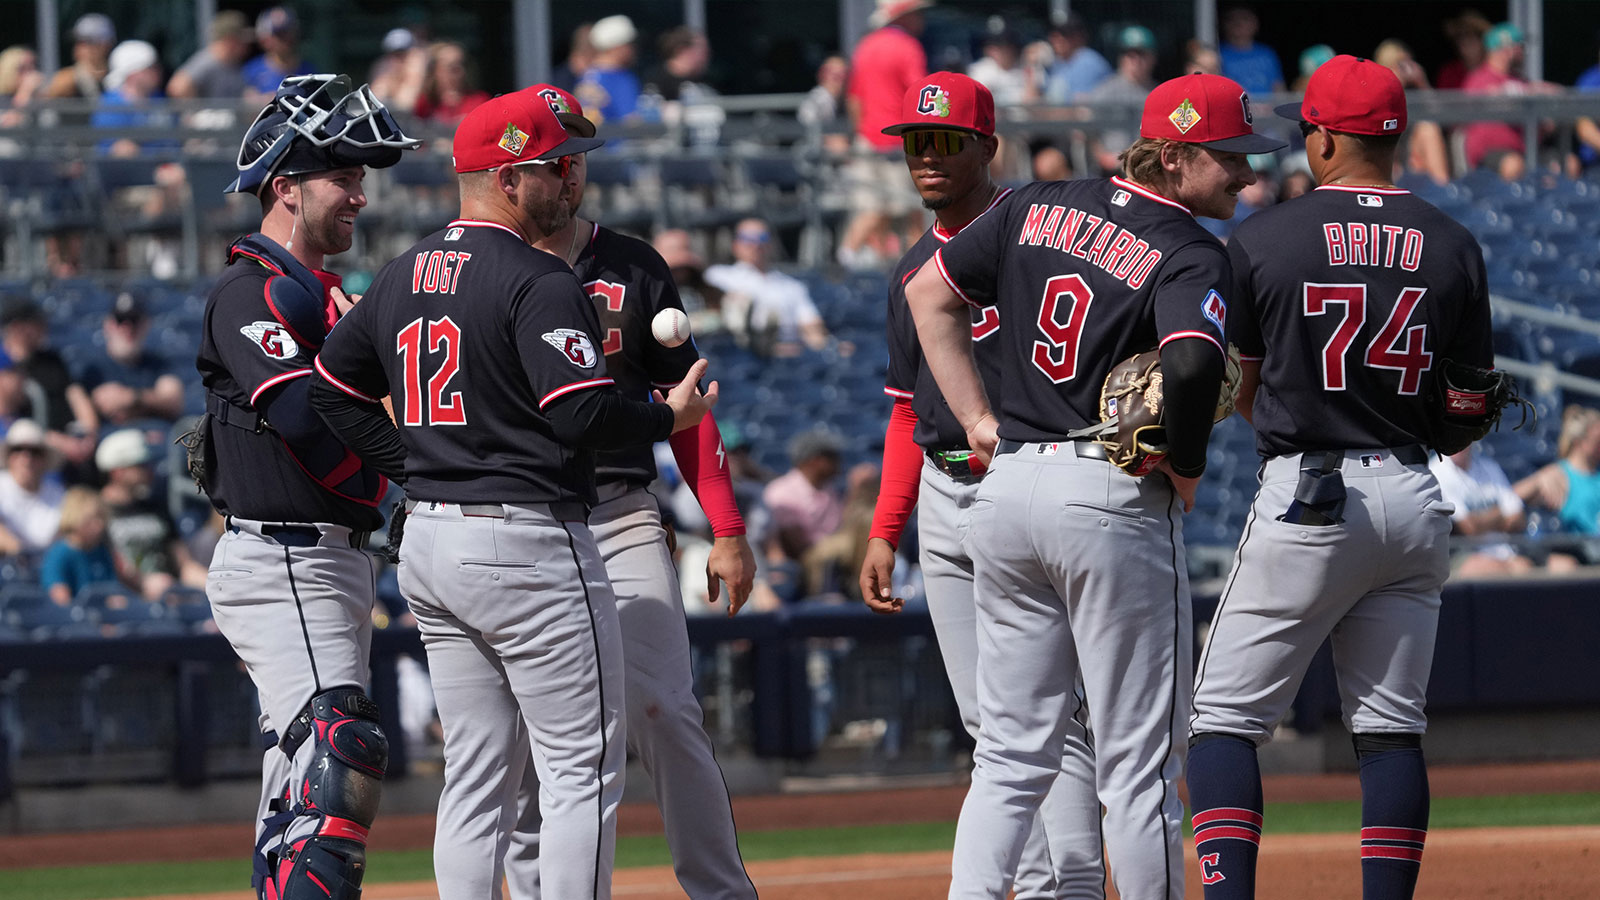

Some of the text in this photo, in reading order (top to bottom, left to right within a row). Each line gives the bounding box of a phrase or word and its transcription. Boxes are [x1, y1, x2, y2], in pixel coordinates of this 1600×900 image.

[916, 84, 940, 115] C
[1175, 108, 1194, 123] 26
[503, 129, 522, 148] 26
[1018, 203, 1163, 291] MANZARDO
[1322, 222, 1425, 272] BRITO
[412, 250, 473, 294] VOGT
[1031, 273, 1095, 384] 9
[1303, 282, 1433, 396] 74
[397, 315, 467, 426] 12
[1199, 852, 1226, 885] C
